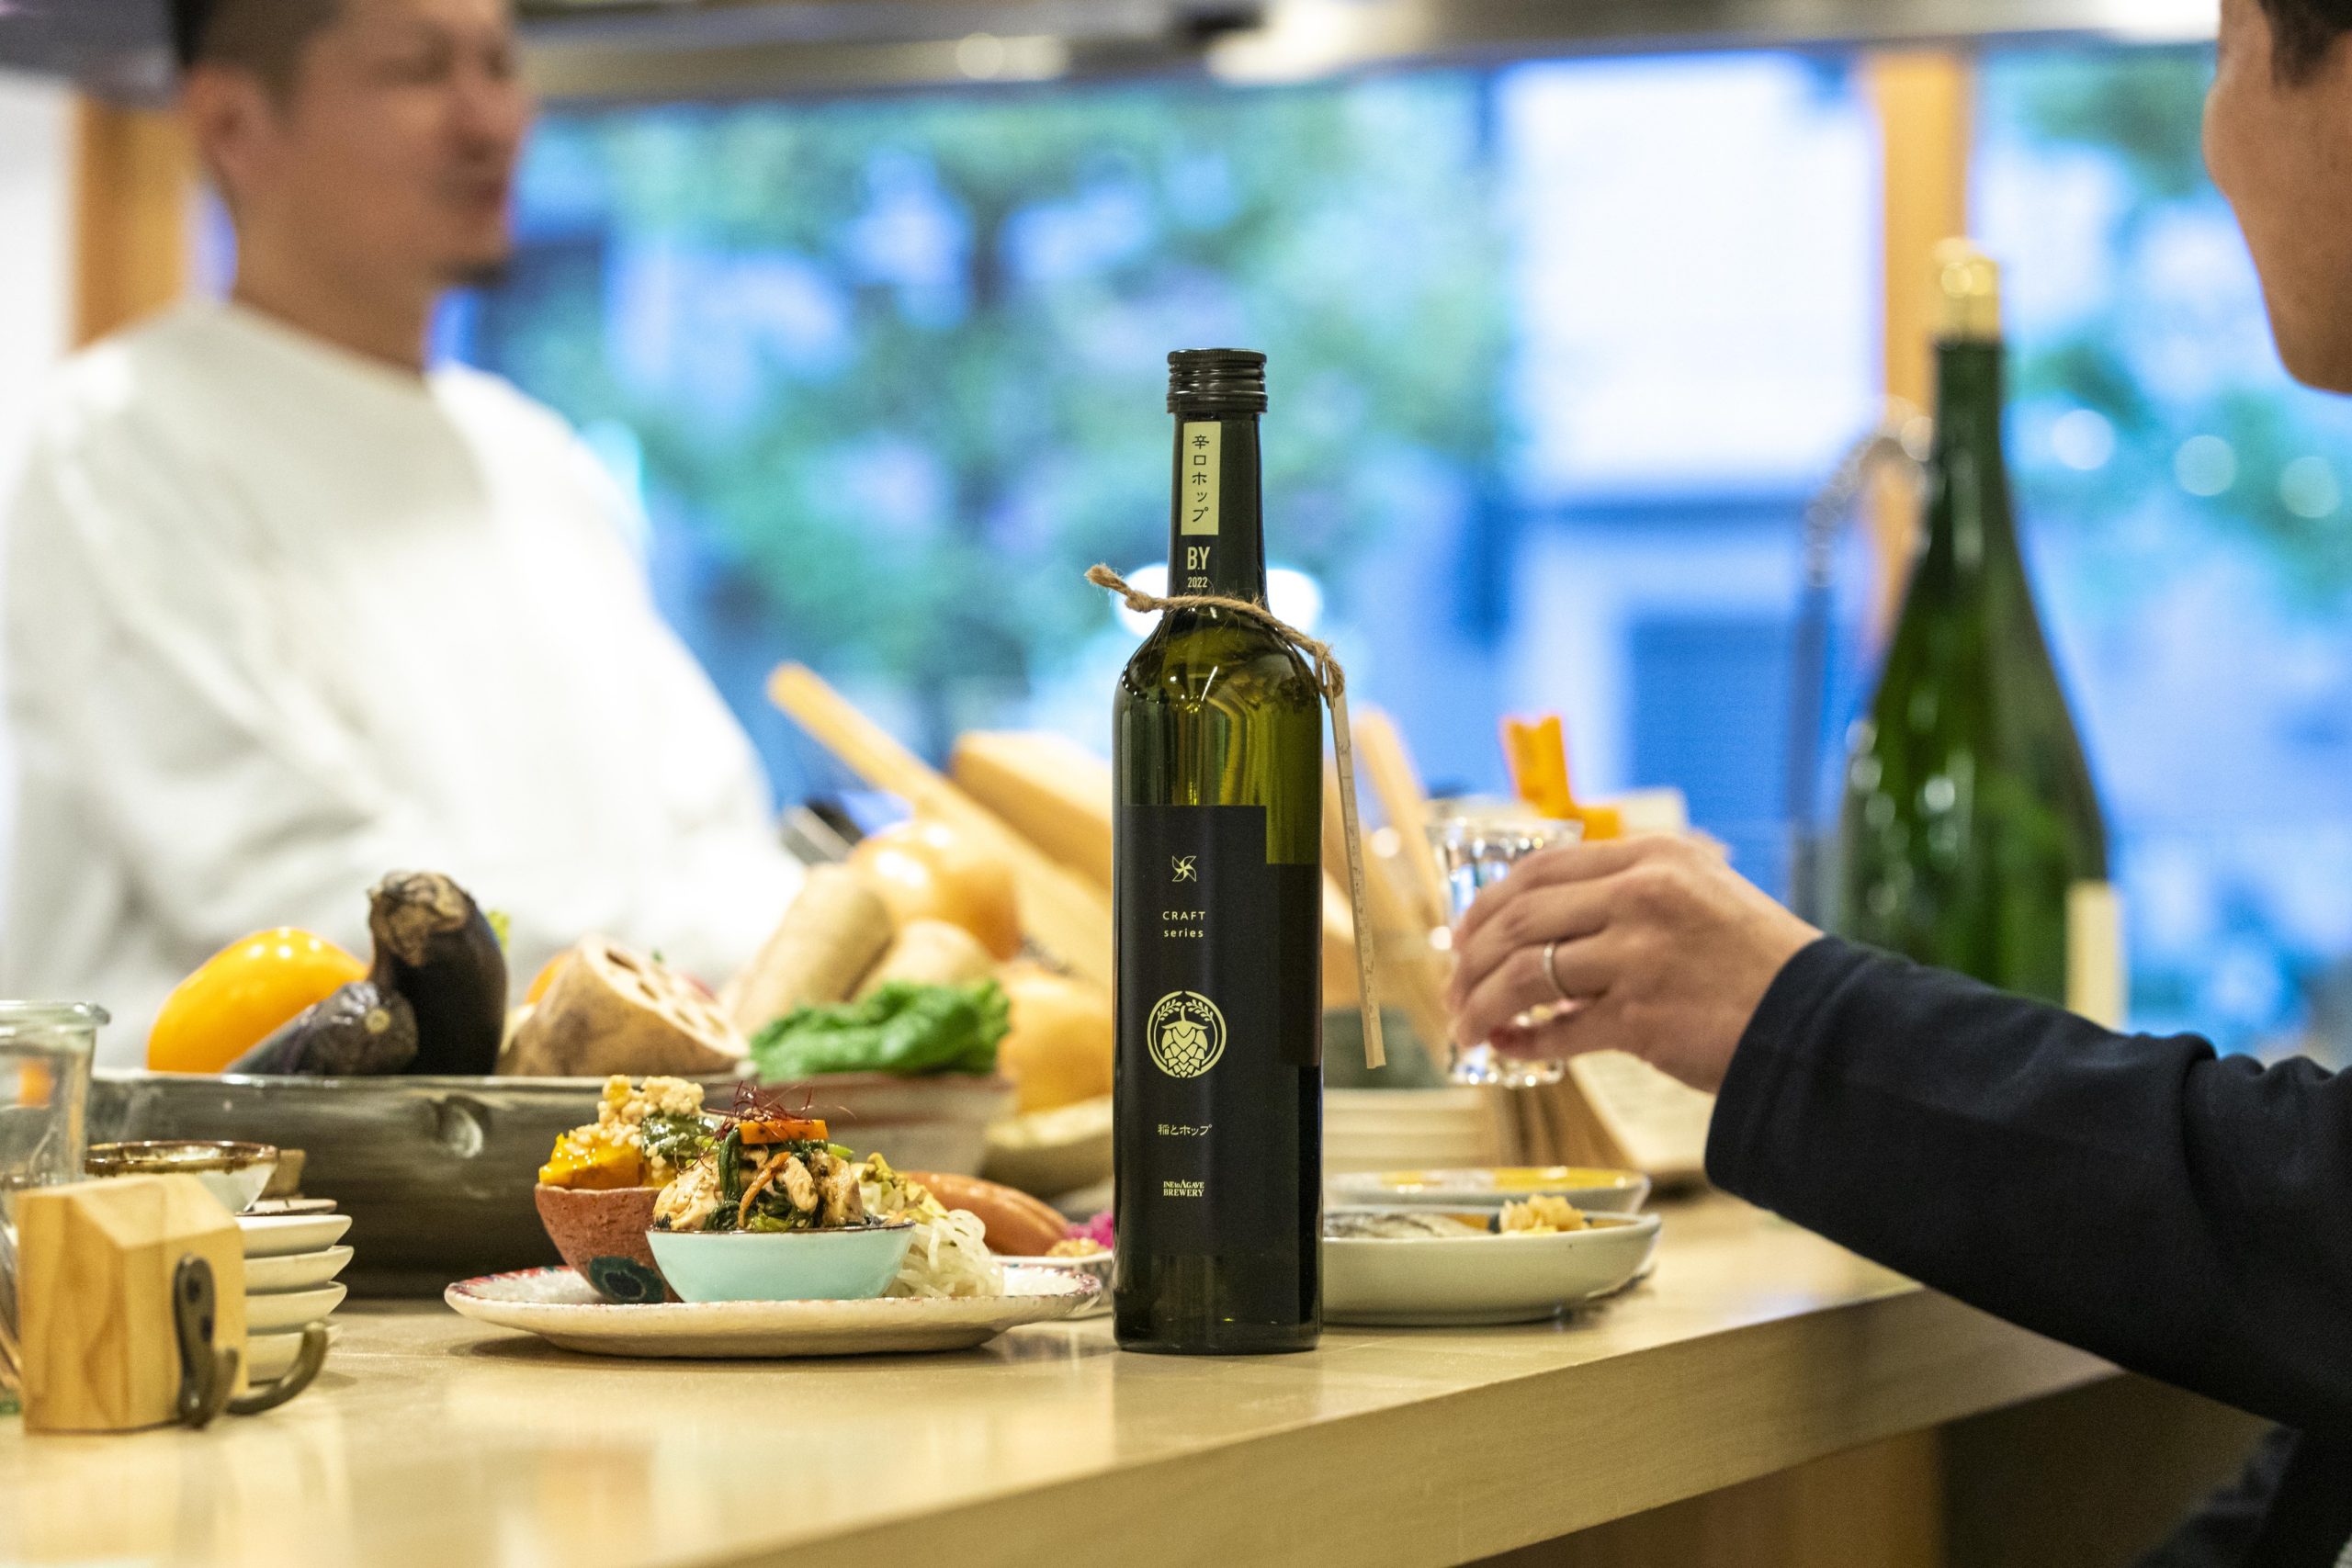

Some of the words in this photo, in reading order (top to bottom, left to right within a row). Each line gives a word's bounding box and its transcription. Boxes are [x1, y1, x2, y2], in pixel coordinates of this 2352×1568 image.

[1192, 434, 1210, 523] 辛口ホップ
[1187, 576, 1208, 589] 2022
[1162, 910, 1206, 921] CRAFT
[1163, 928, 1204, 938] series
[1157, 1123, 1213, 1136] 稲とホップ
[1163, 1189, 1204, 1198] BREWERY
